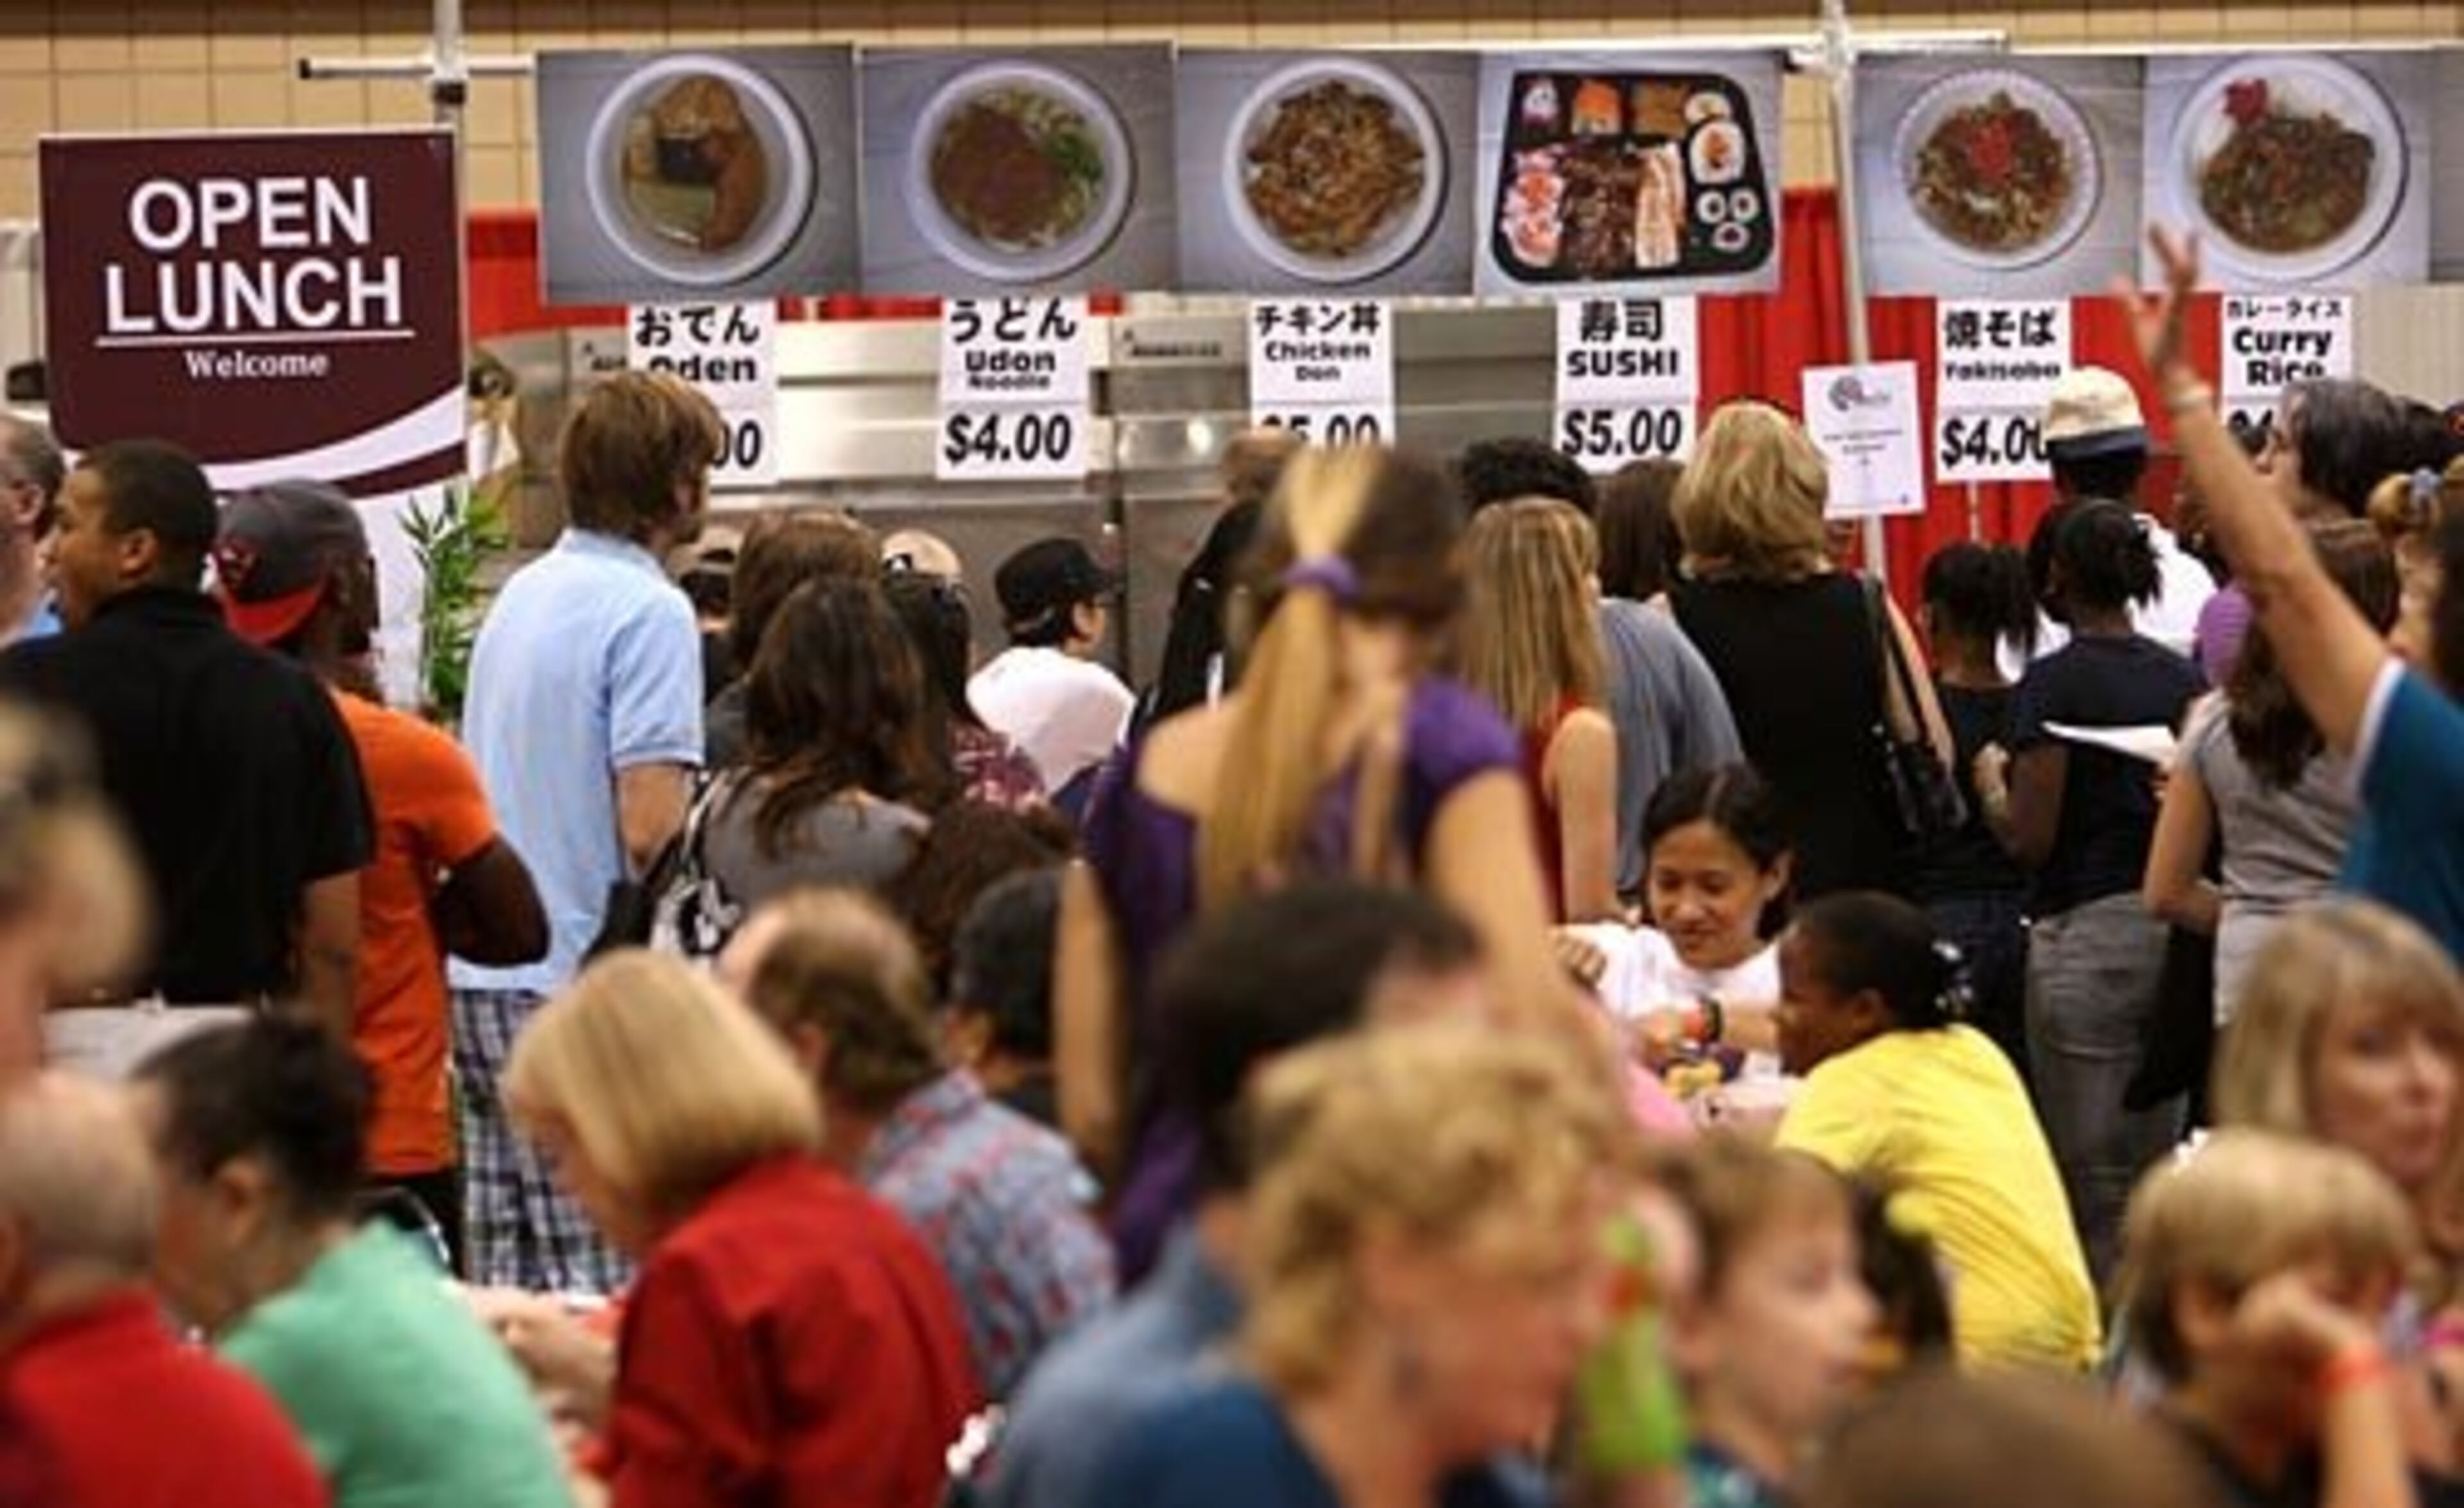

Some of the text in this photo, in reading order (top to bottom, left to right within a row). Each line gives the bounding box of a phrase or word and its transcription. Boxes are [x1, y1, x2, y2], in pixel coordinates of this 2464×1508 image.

[130, 177, 370, 250] OPEN
[106, 257, 402, 332] LUNCH
[635, 305, 760, 347] おでん
[950, 296, 1077, 344] うどん
[1255, 302, 1380, 337] チキン丼
[1580, 299, 1664, 343] 寿司
[965, 348, 1056, 372] Udon
[1265, 339, 1371, 362] Chicken
[2232, 327, 2332, 356] Curry
[185, 350, 329, 377] Welcome
[1566, 349, 1679, 377] SUSHI
[945, 413, 1072, 467] $4.00
[1562, 409, 1682, 456] $5.00
